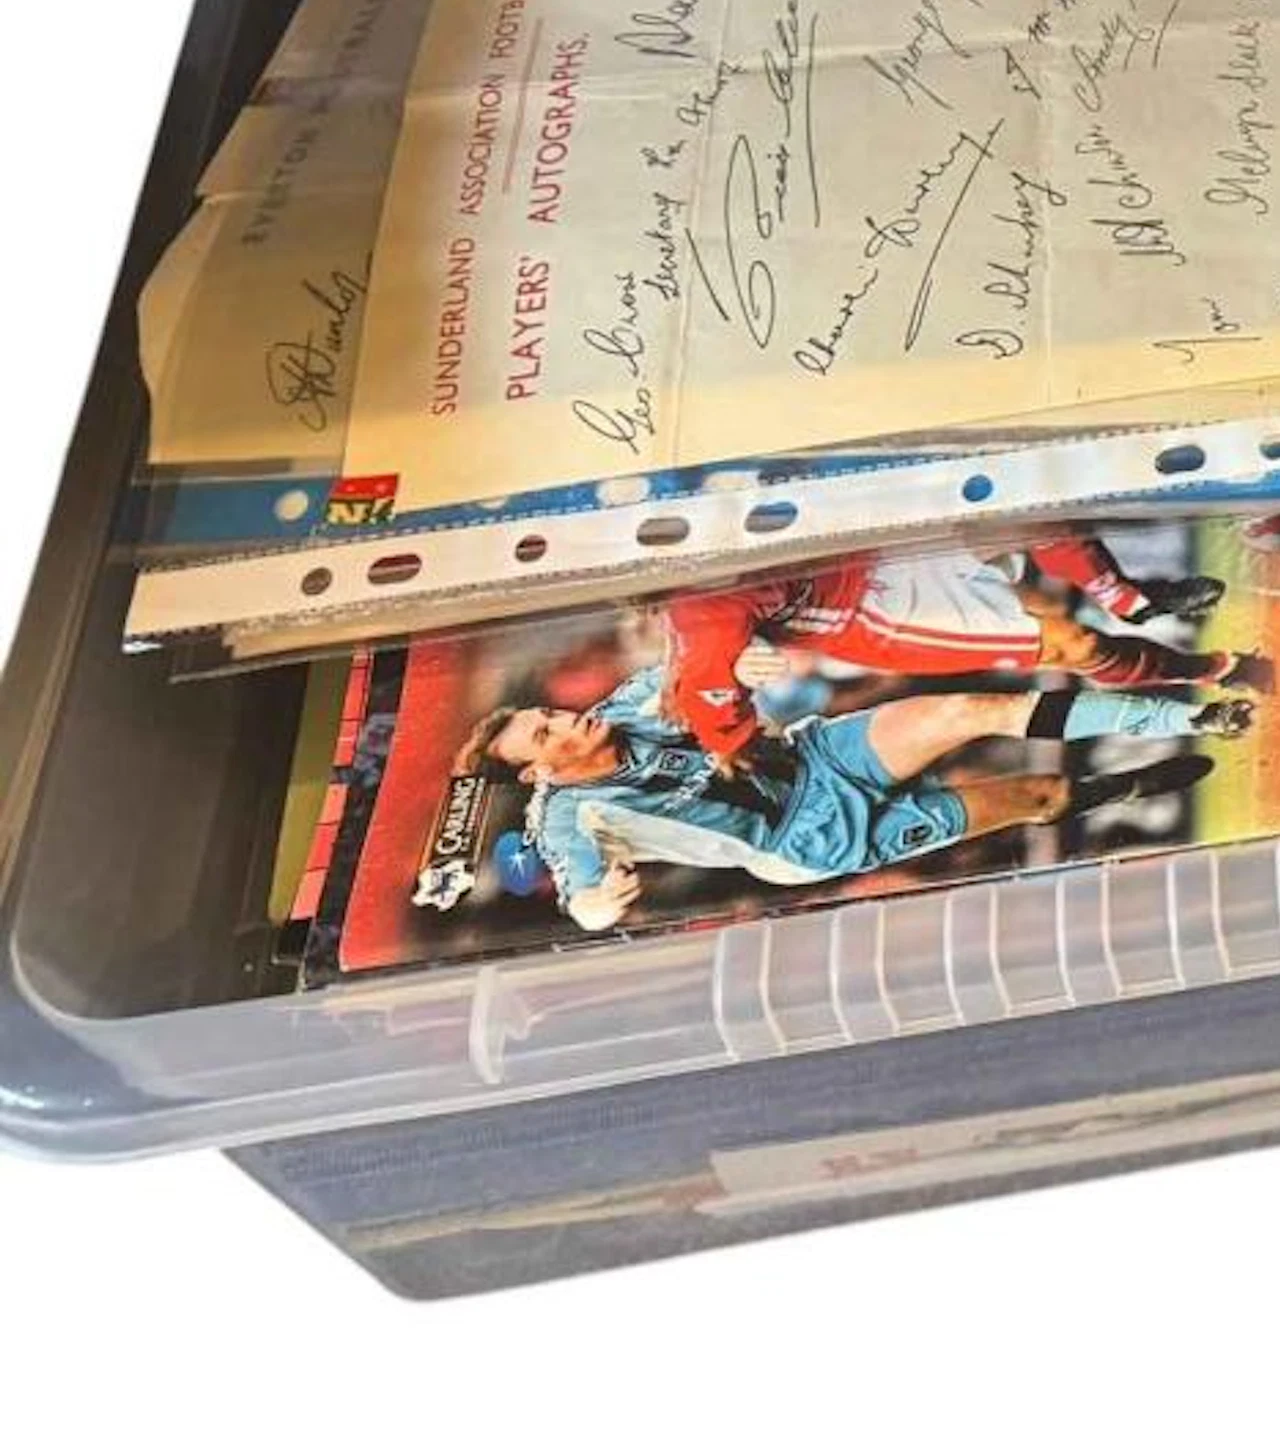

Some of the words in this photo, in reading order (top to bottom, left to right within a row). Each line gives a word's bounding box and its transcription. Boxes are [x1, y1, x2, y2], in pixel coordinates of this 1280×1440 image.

[433, 237, 476, 415] SUNDERLAND
[463, 73, 505, 217] ASSOCIATION
[506, 257, 551, 401] PLAYERS'
[436, 776, 473, 854] CARLING
